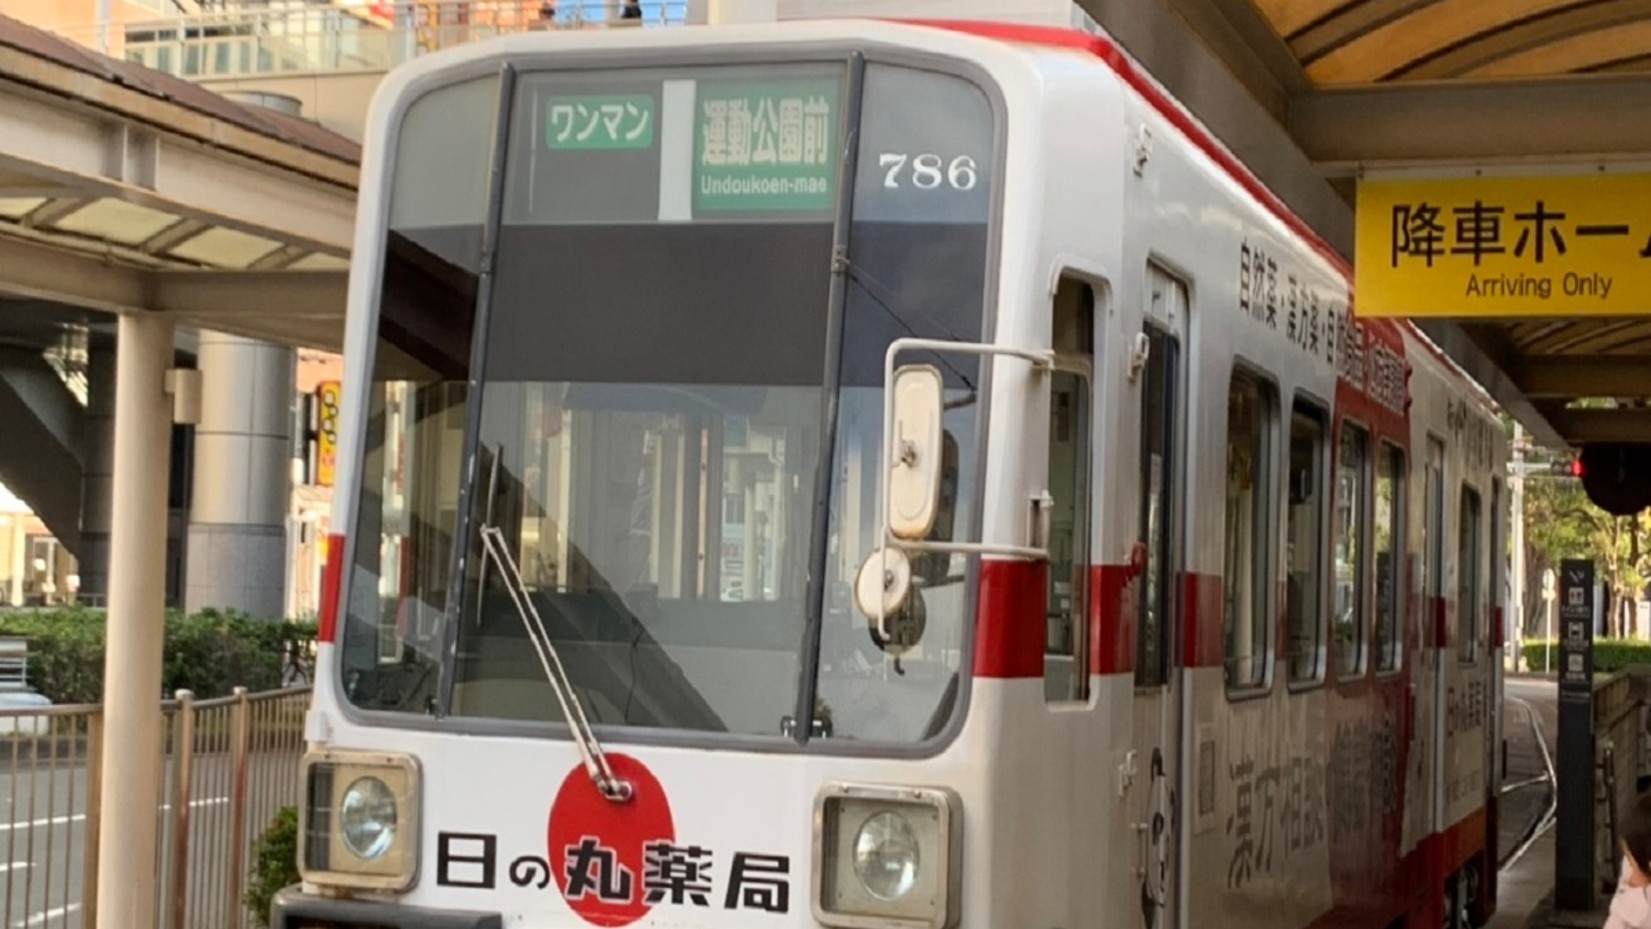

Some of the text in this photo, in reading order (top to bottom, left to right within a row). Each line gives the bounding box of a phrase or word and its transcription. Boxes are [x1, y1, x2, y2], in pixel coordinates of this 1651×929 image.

[551, 103, 652, 143] ワンマン
[701, 96, 830, 167] 運動公園前
[701, 174, 828, 196] Undoukoen-mae
[878, 152, 978, 191] 786
[1465, 271, 1613, 300] Arriving Only
[435, 831, 791, 915] 日の丸薬局
